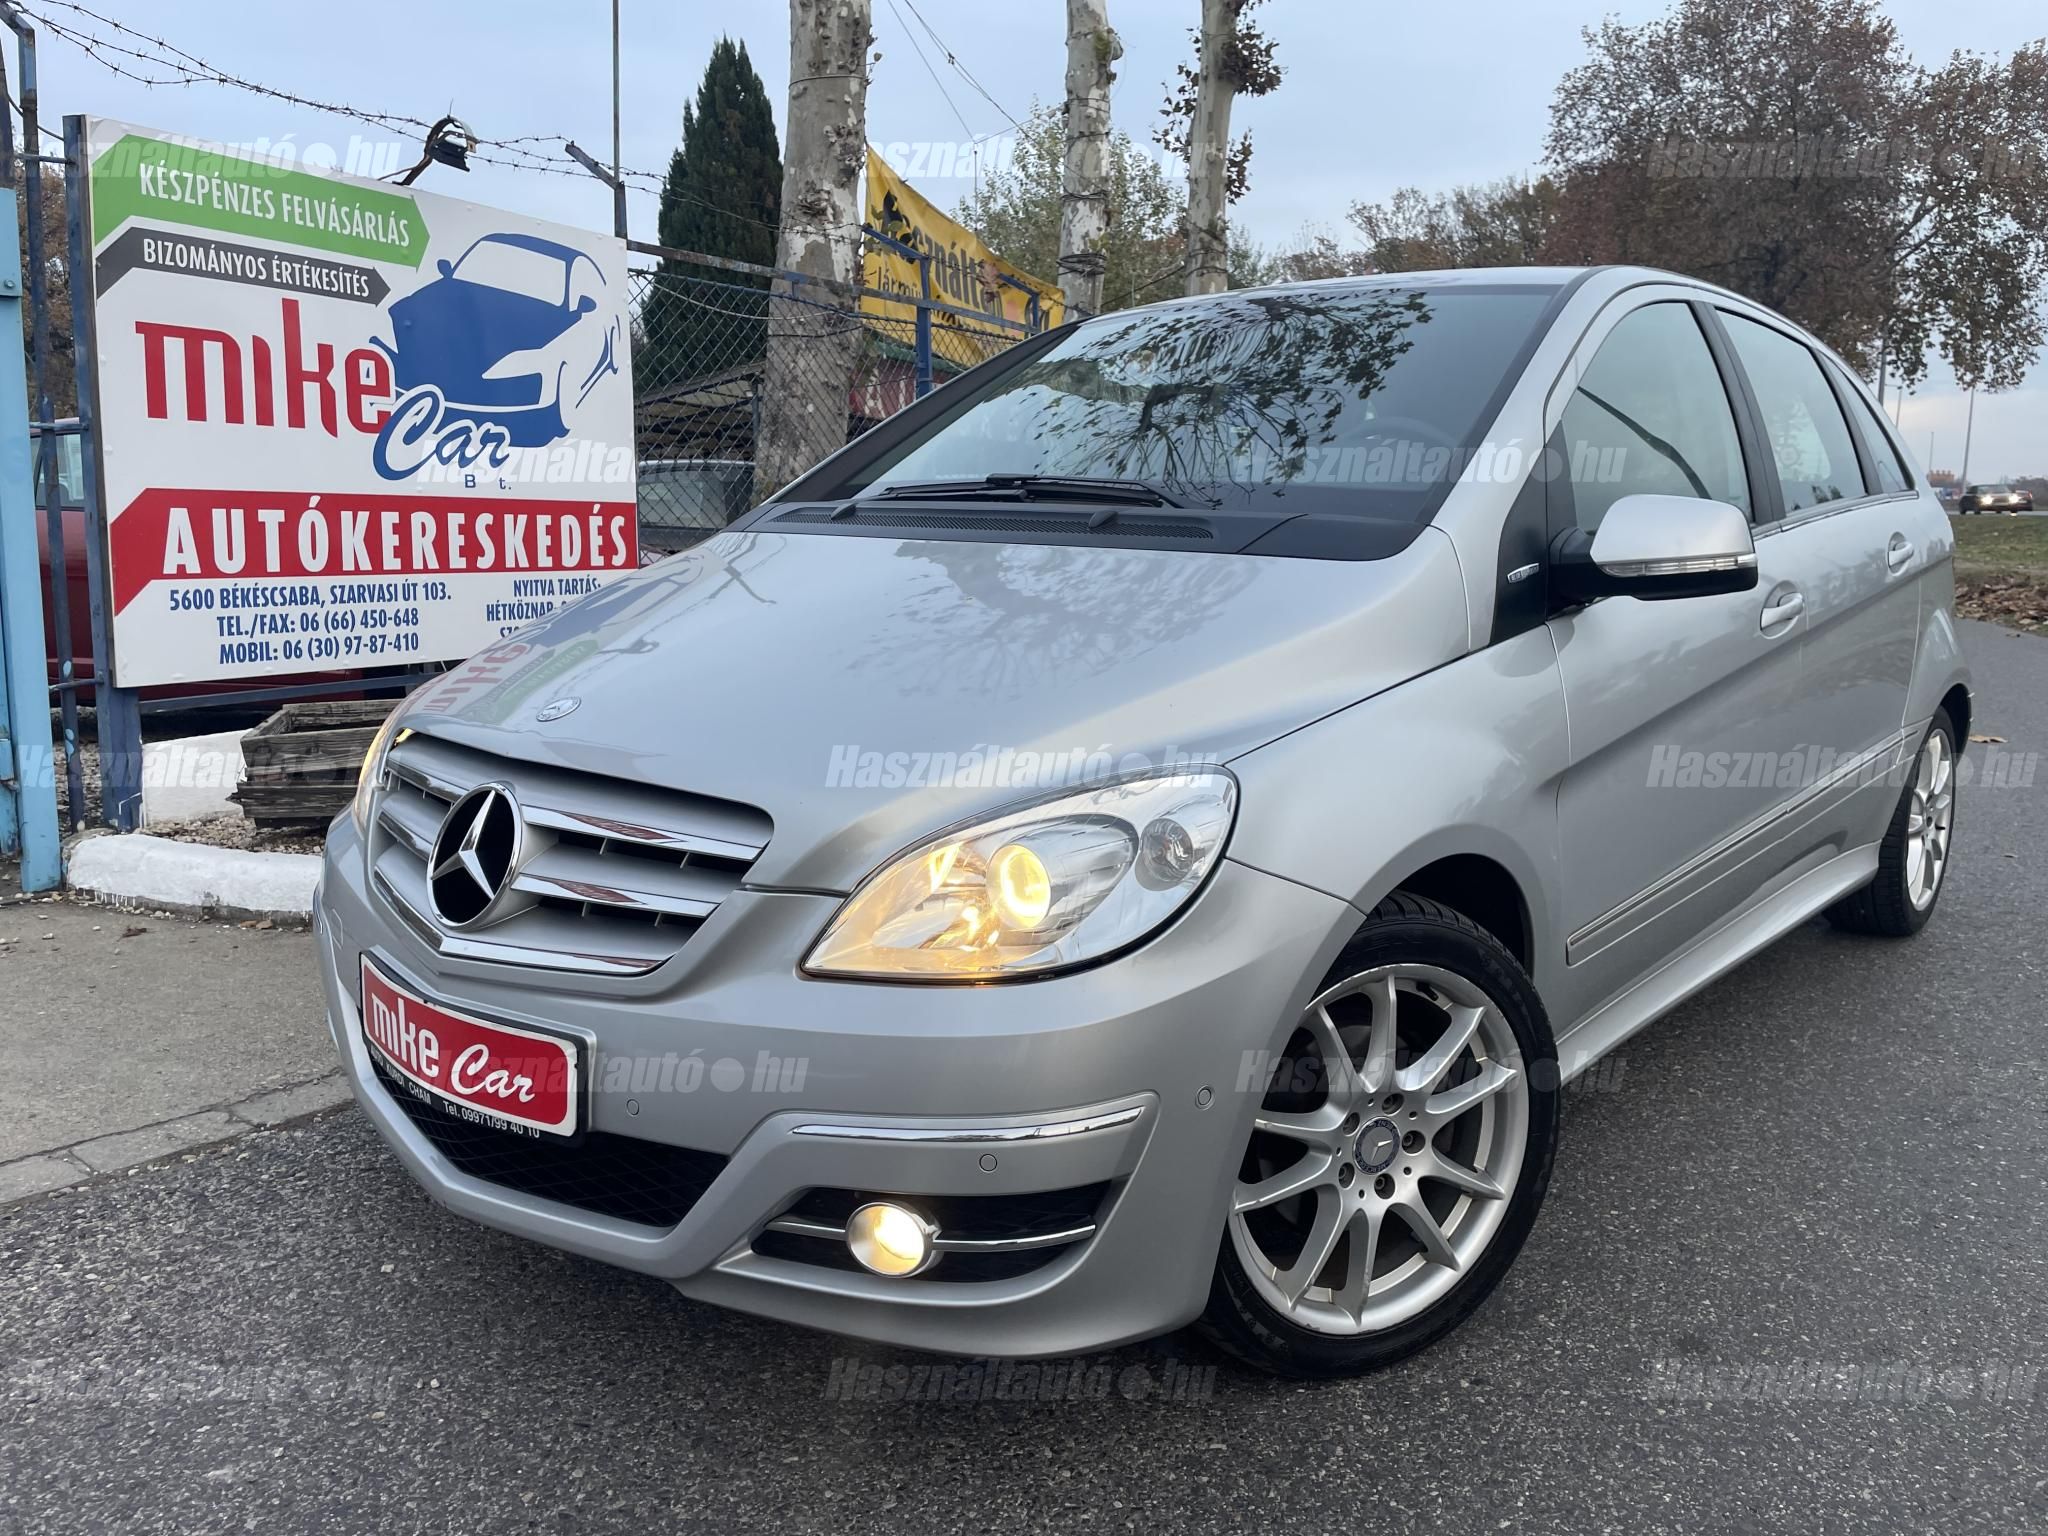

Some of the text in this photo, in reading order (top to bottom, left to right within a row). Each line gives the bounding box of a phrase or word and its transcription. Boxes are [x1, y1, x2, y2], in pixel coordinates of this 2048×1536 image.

[140, 158, 410, 247] KÉSZPÉNZES FELVÁSÁRLÁS
[143, 238, 370, 298] BIZOMÁNYOS ÉRTÉKESÍTÉS
[372, 386, 512, 481] Car
[162, 495, 627, 575] AUTÓKERESKEDÉS
[169, 578, 452, 611] 5600 BÉKÉSCSABA, SZARVASI ÚT 103.
[513, 579, 555, 598] NYITVA
[217, 607, 419, 639] TEL./FAX: 06 (66) 450-648
[219, 632, 419, 665] MOBIL: 06 (30) 97-87-410
[371, 992, 536, 1104] mike Car
[408, 1080, 432, 1105] CHAM
[442, 1100, 461, 1118] Tel.
